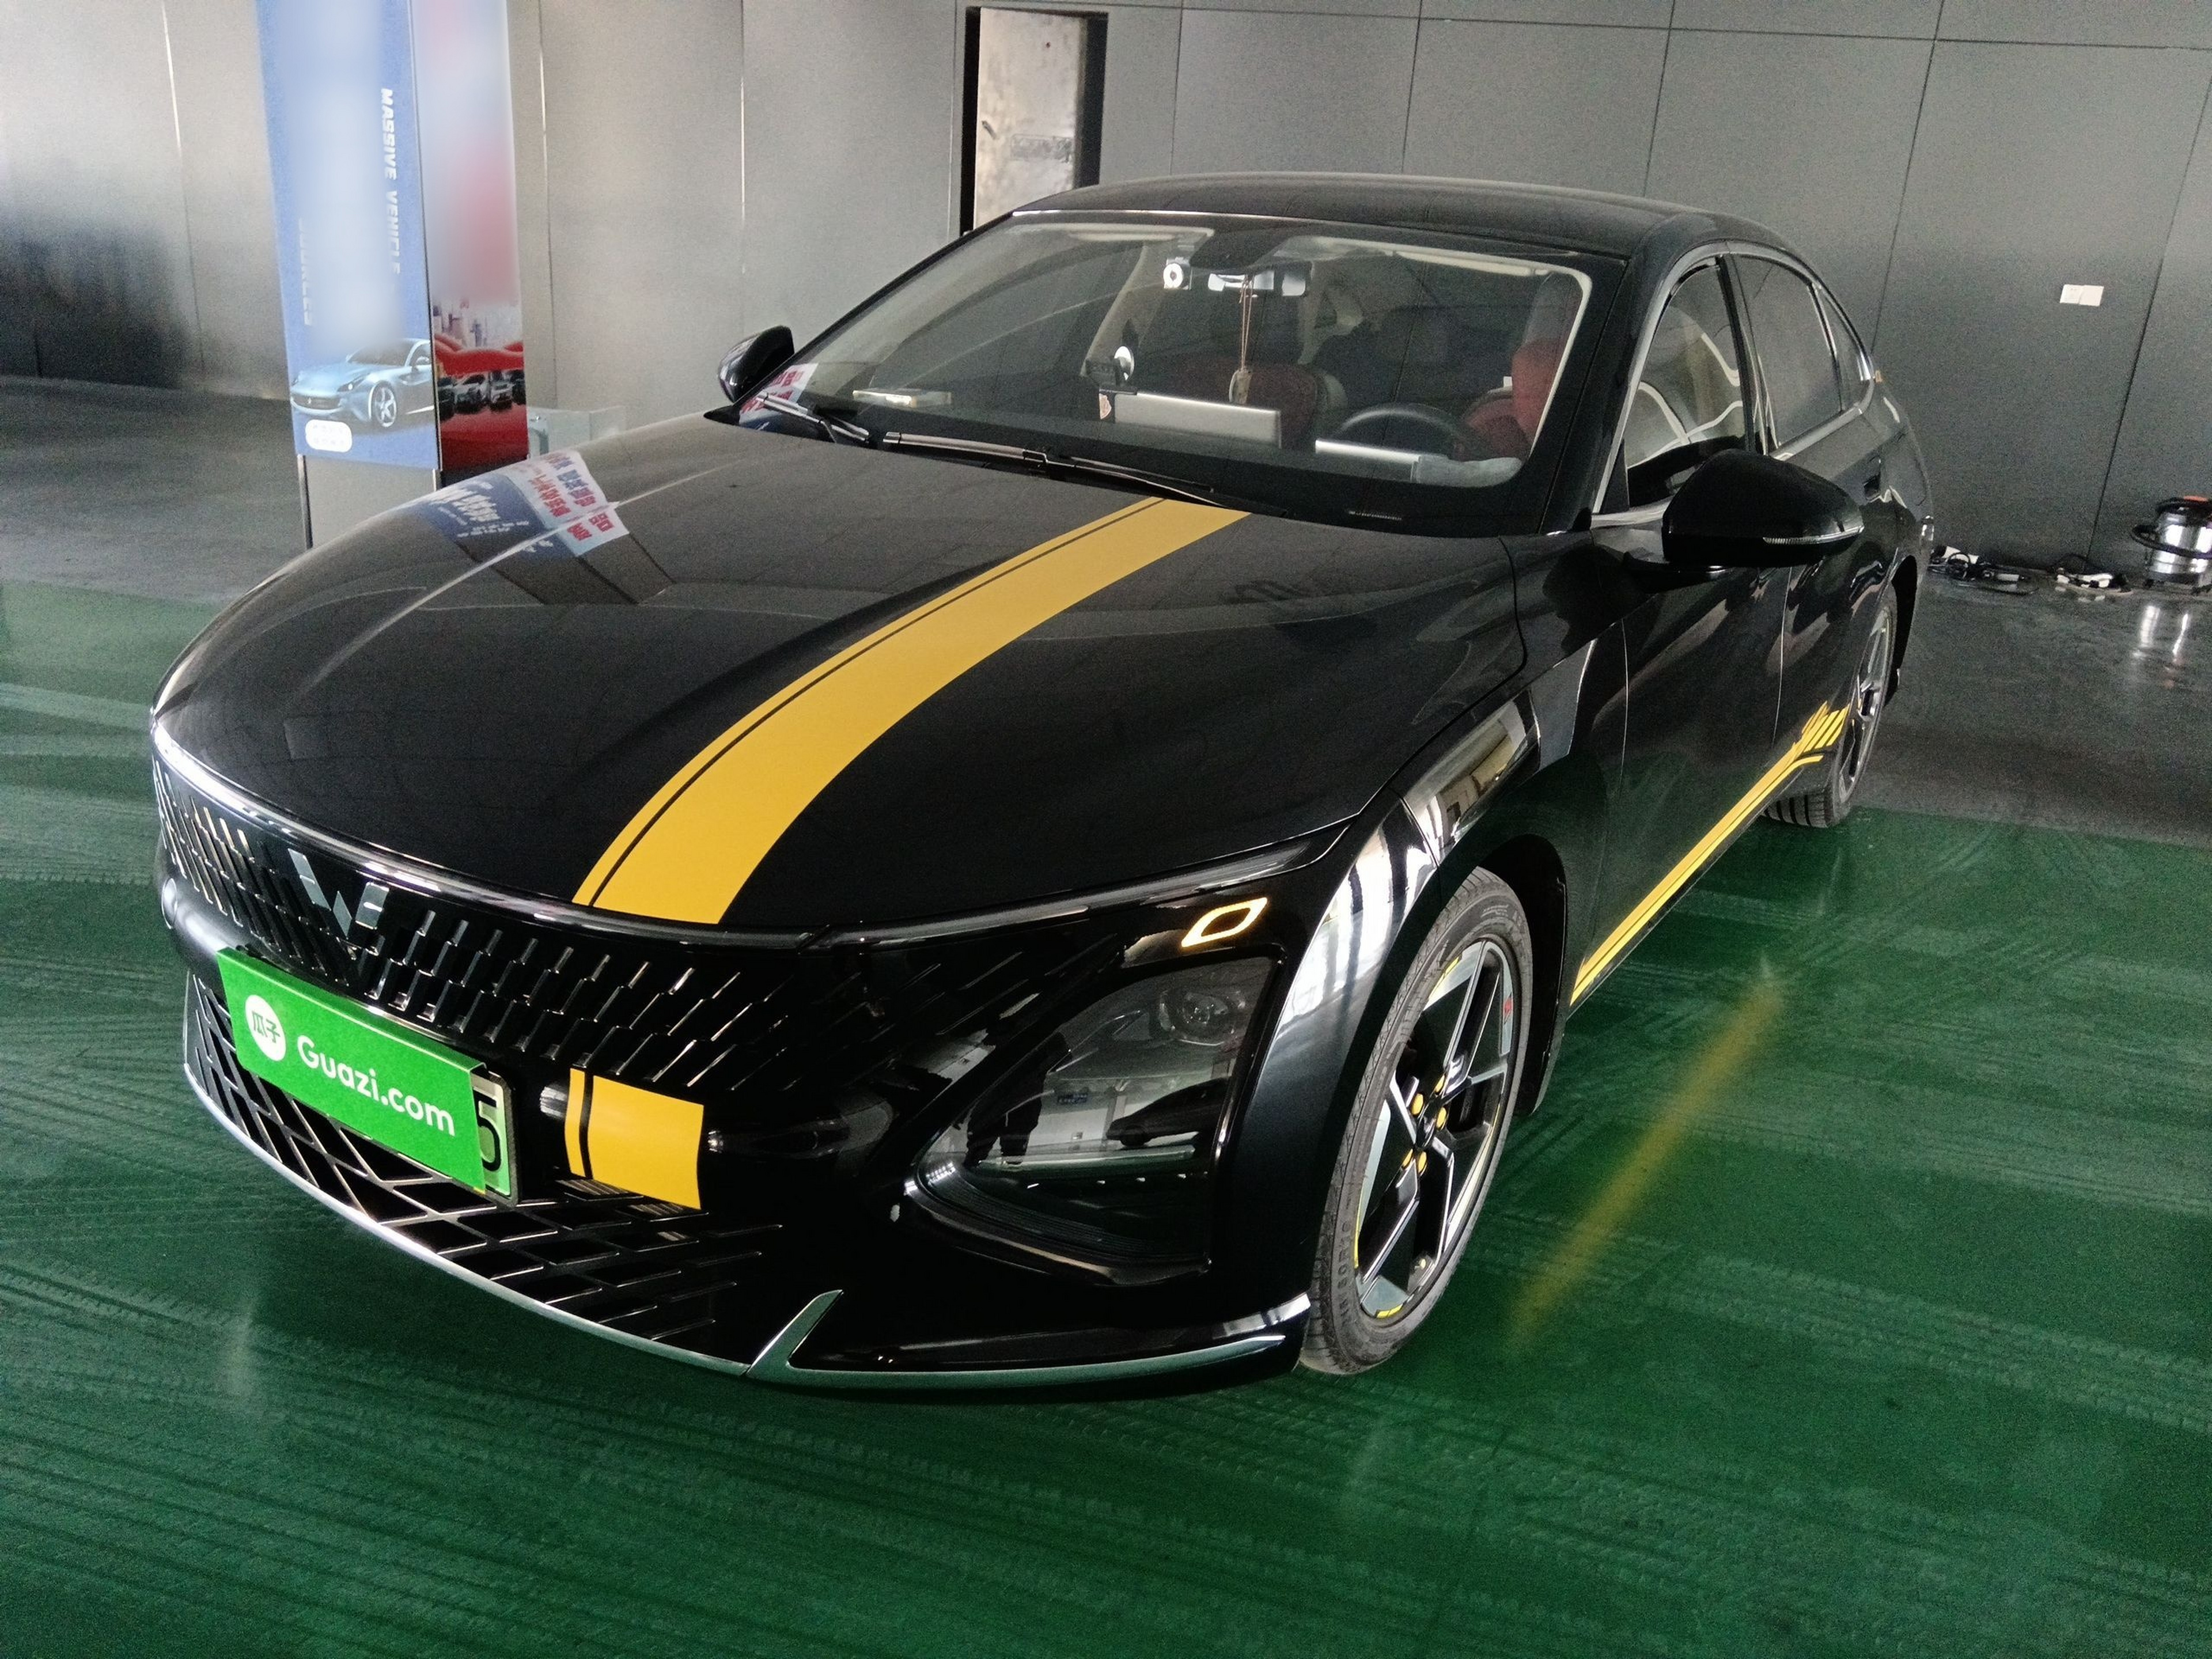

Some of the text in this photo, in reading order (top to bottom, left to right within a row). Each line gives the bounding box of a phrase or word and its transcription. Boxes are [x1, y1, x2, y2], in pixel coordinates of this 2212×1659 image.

[381, 88, 397, 180] MASSIVE
[252, 1011, 281, 1043] 瓜子
[297, 1035, 455, 1137] Guazi.com
